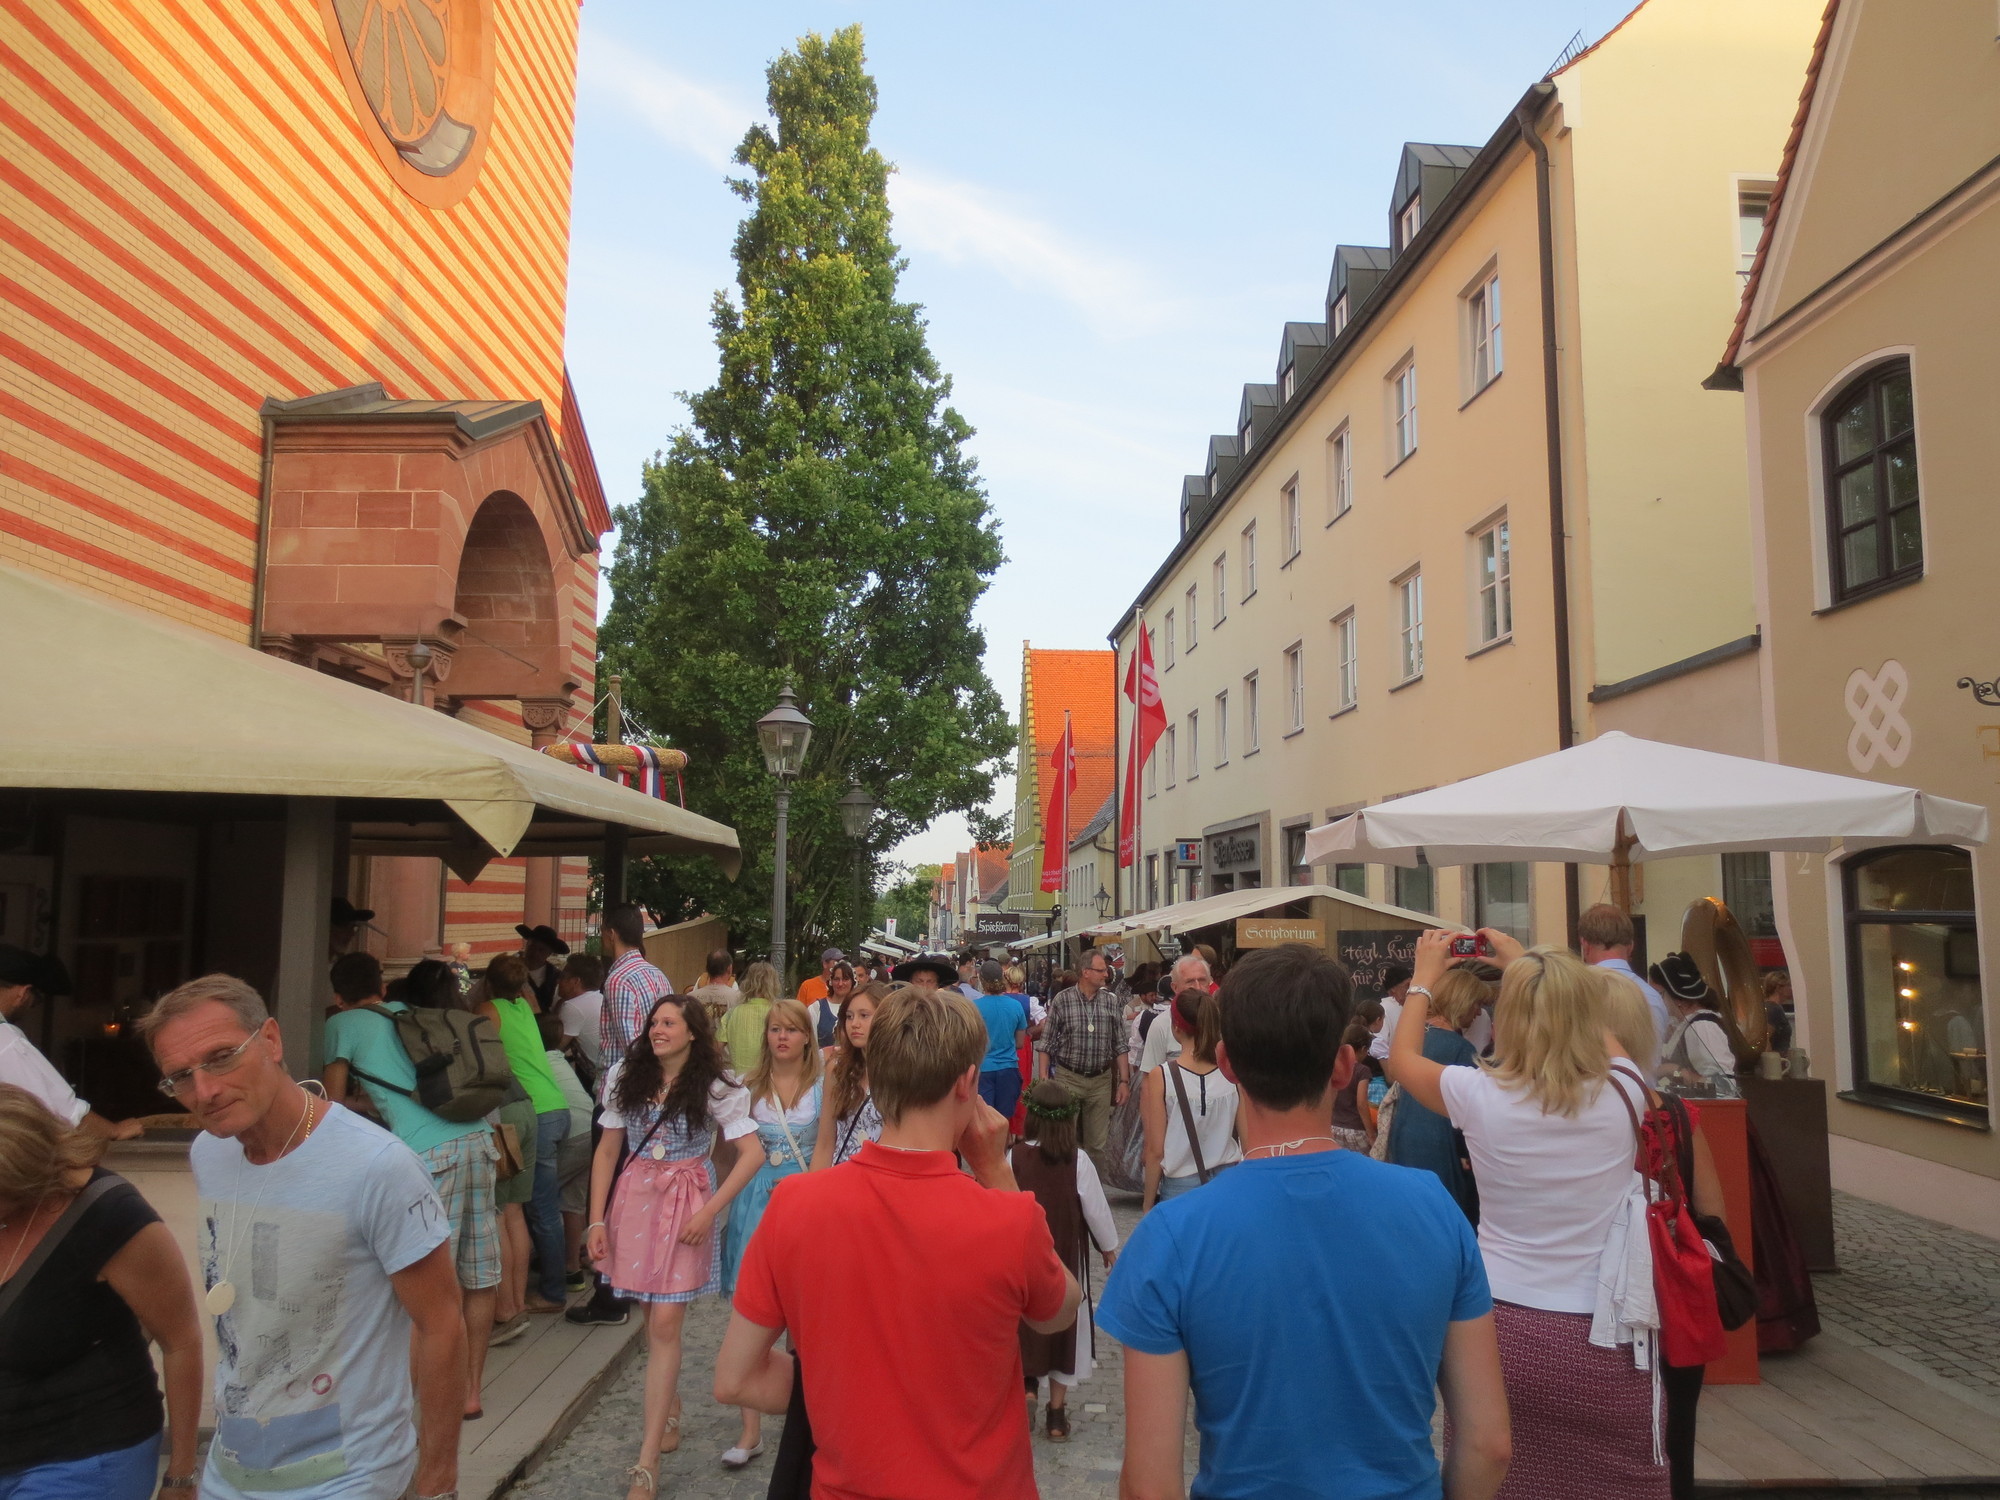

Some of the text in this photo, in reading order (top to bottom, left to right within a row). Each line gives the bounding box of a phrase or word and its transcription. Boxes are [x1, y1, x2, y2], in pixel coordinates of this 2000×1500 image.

[1245, 926, 1316, 941] Scriptorium
[1341, 942, 1382, 965] tägl.
[1350, 966, 1374, 988] für
